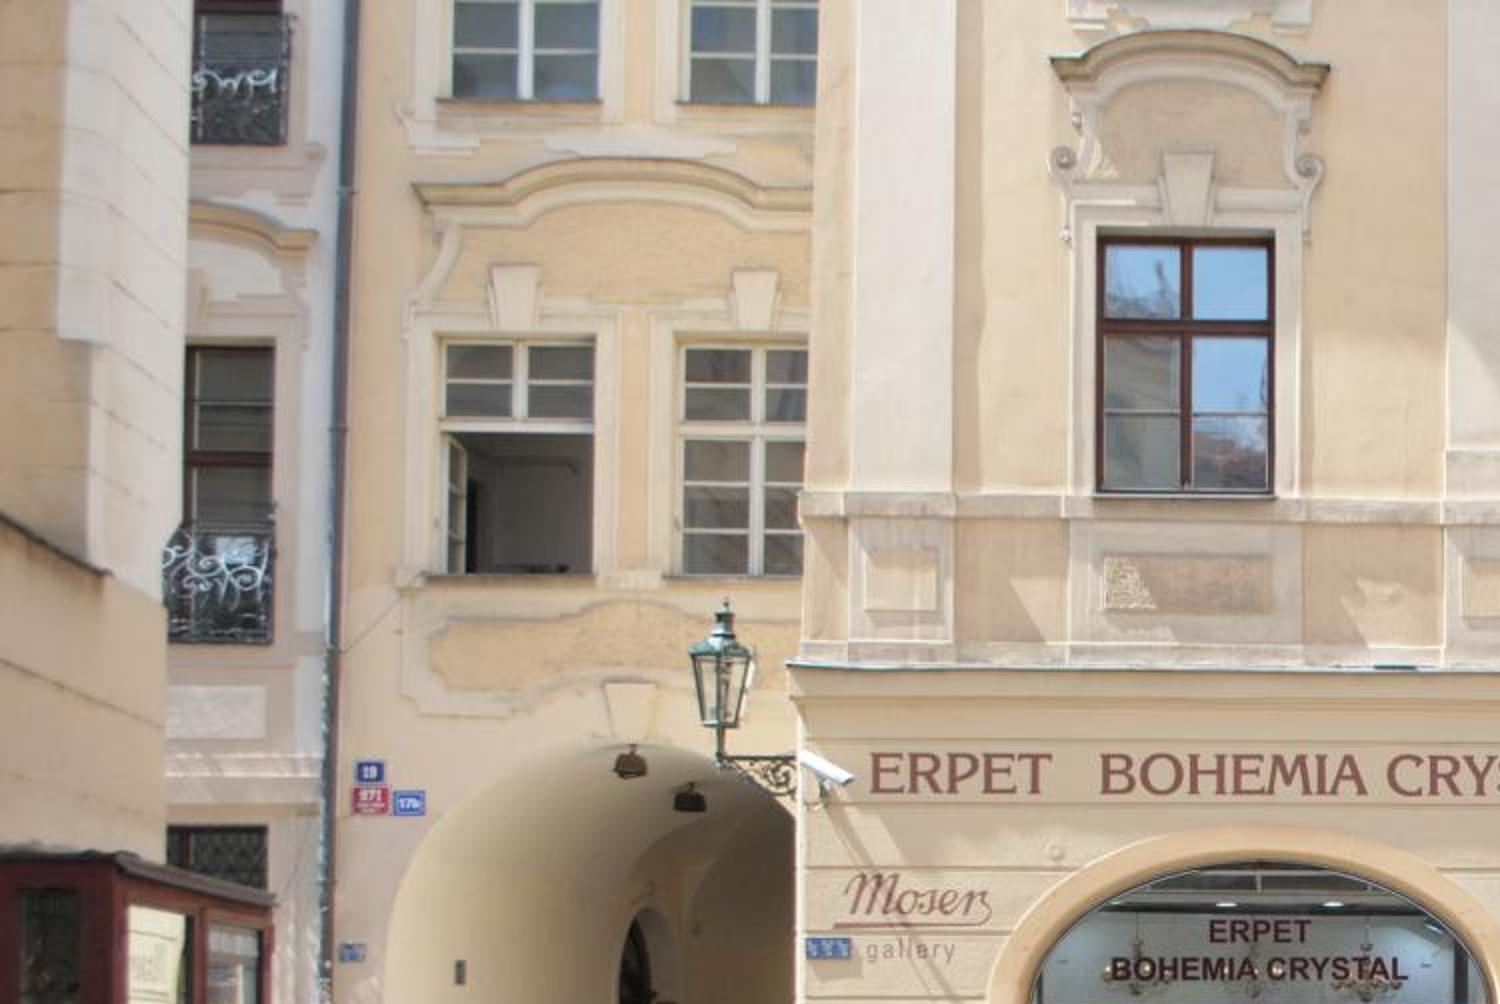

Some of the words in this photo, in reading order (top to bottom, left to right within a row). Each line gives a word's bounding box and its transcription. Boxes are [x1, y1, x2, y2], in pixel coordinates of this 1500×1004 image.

[869, 752, 1053, 795] ERPET
[1099, 752, 1370, 797] BOHEMIA
[834, 870, 993, 928] Moser
[1208, 918, 1312, 944] ERPET
[865, 937, 957, 964] gallery
[1110, 956, 1256, 983] BOHEMIA
[1266, 956, 1409, 983] CRYSTAL
